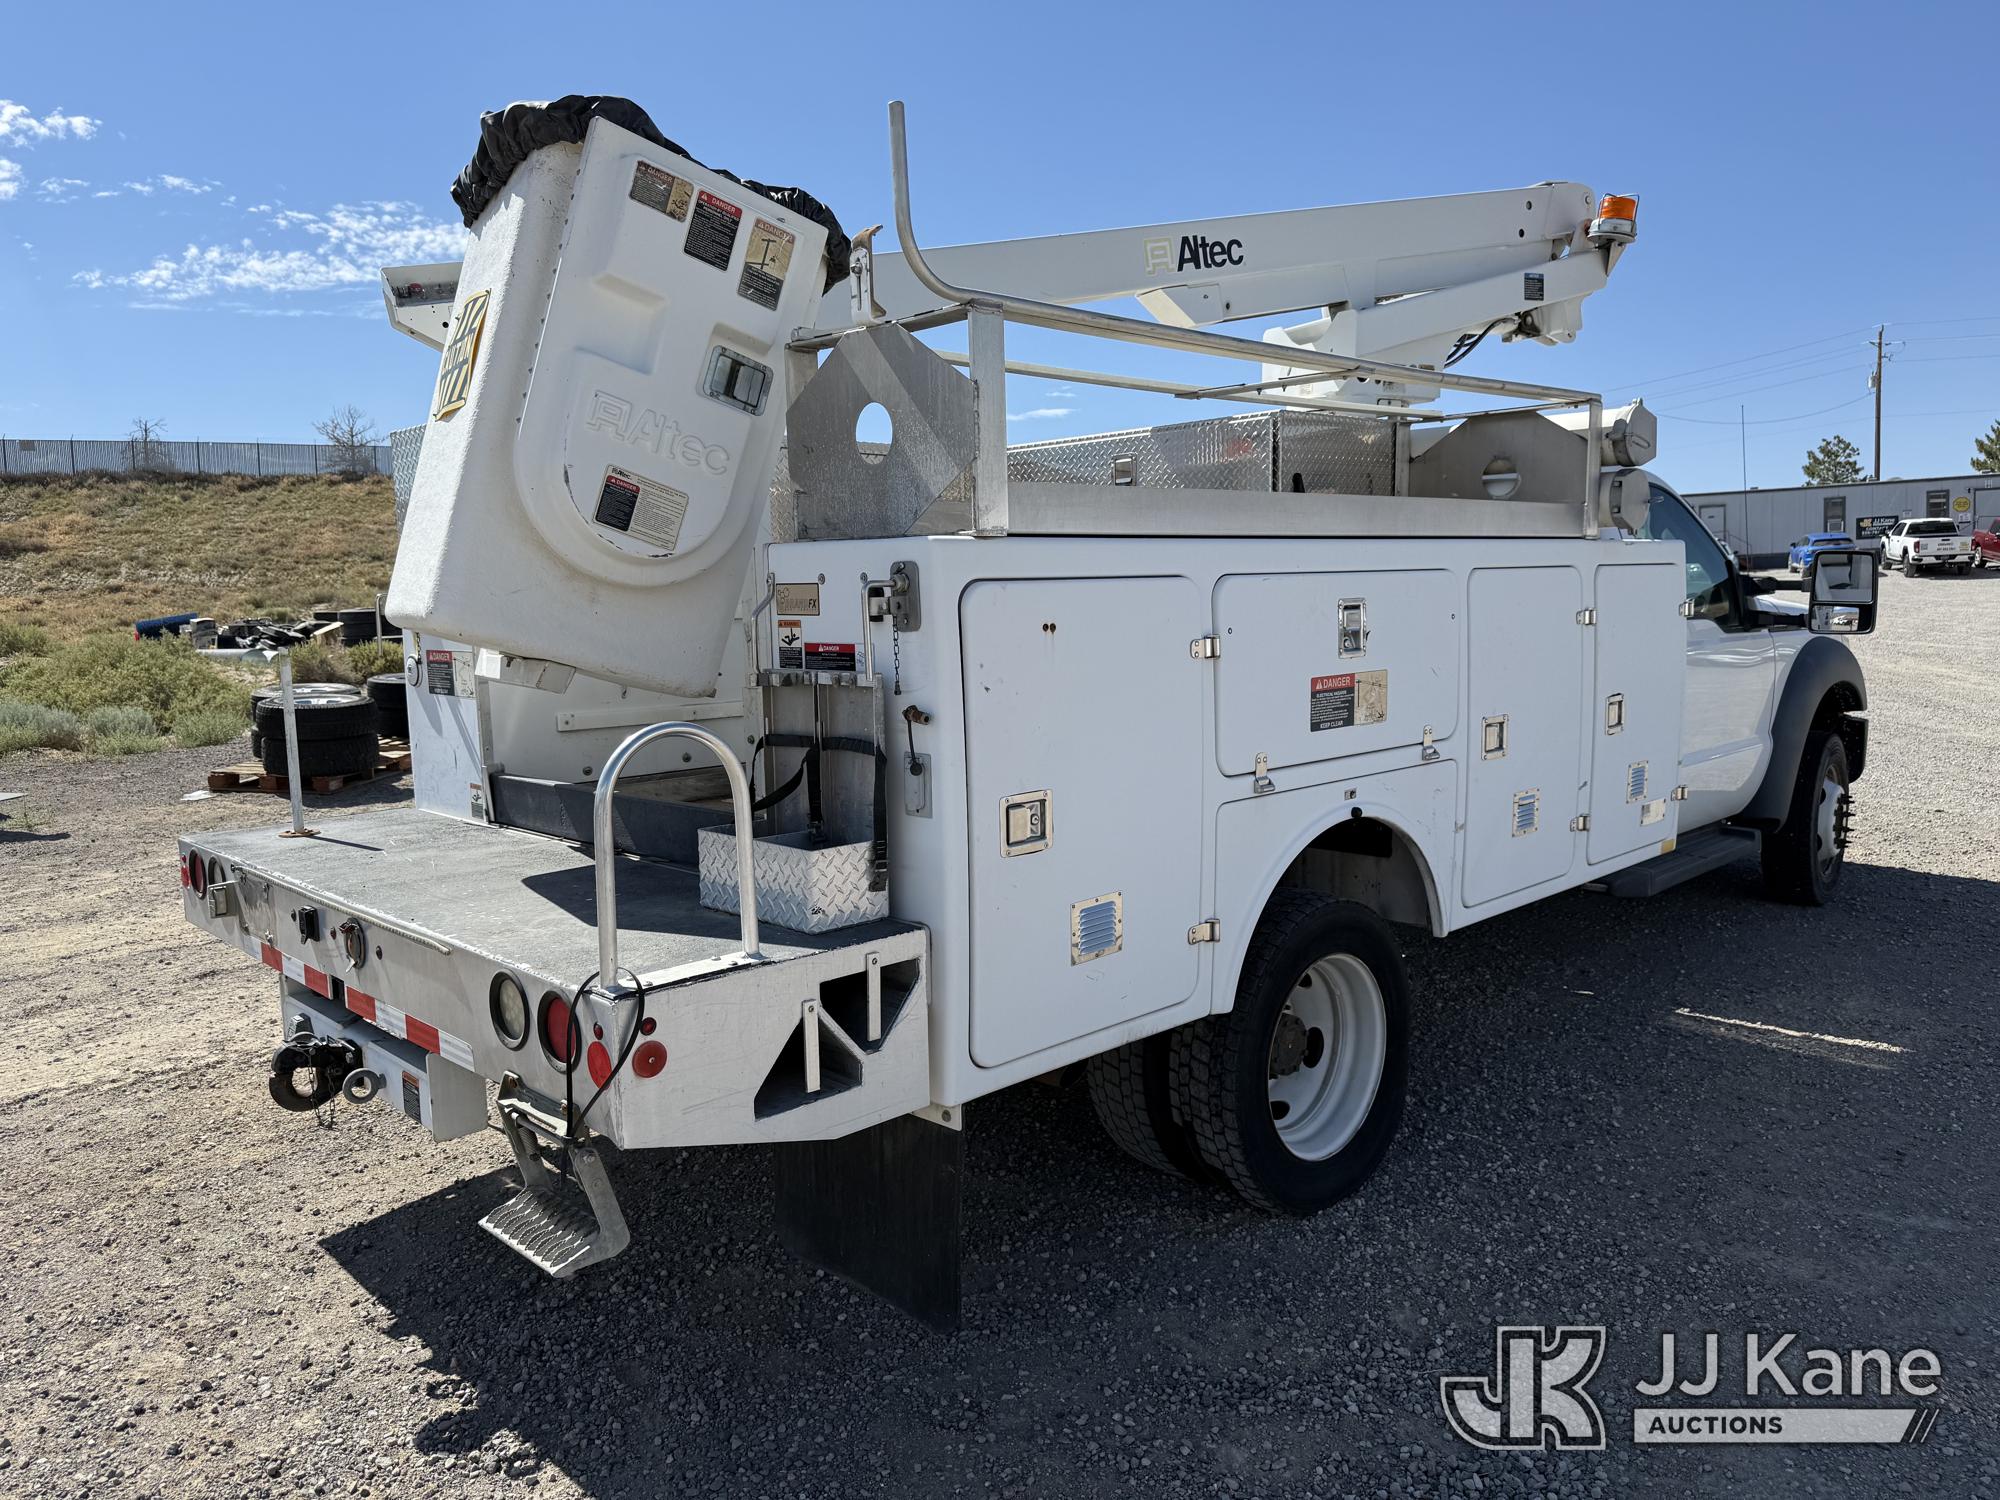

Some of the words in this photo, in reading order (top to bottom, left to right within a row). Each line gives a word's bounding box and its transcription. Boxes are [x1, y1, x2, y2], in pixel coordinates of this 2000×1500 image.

[648, 167, 673, 182] DANGER
[711, 198, 736, 214] DANGER
[1177, 234, 1244, 272] Altec
[626, 407, 730, 475] Altec
[616, 480, 637, 491] DANGER
[1323, 676, 1351, 689] DANGER
